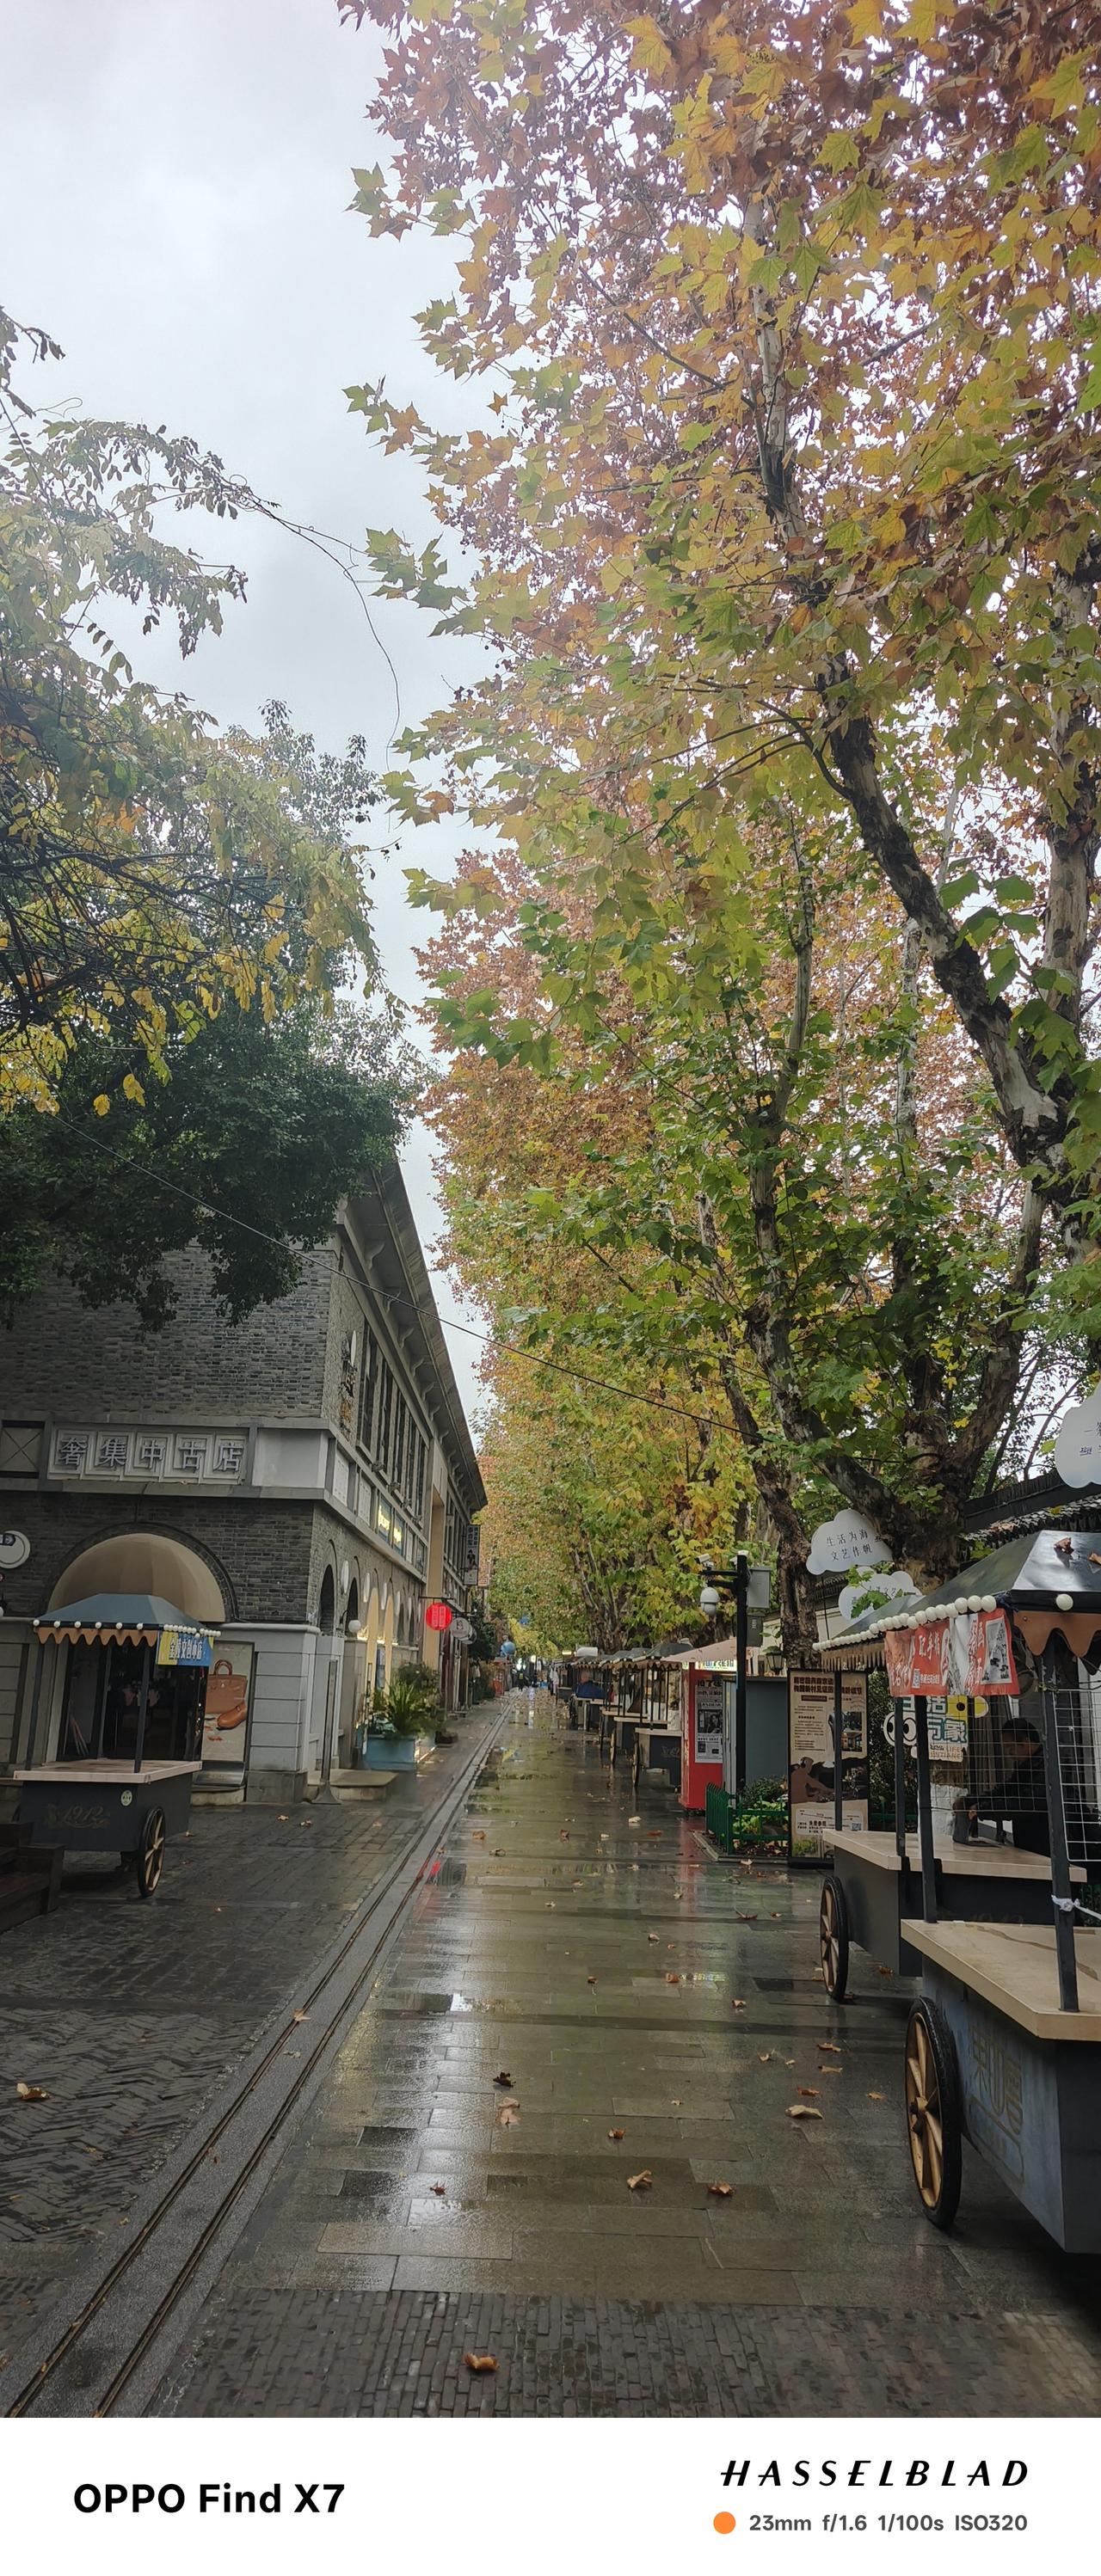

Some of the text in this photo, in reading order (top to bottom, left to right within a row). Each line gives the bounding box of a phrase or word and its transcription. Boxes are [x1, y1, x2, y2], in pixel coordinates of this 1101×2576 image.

[58, 1437, 244, 1472] 奢集中古店
[827, 1529, 868, 1547] 生活为海
[831, 1544, 872, 1561] 文艺作帆
